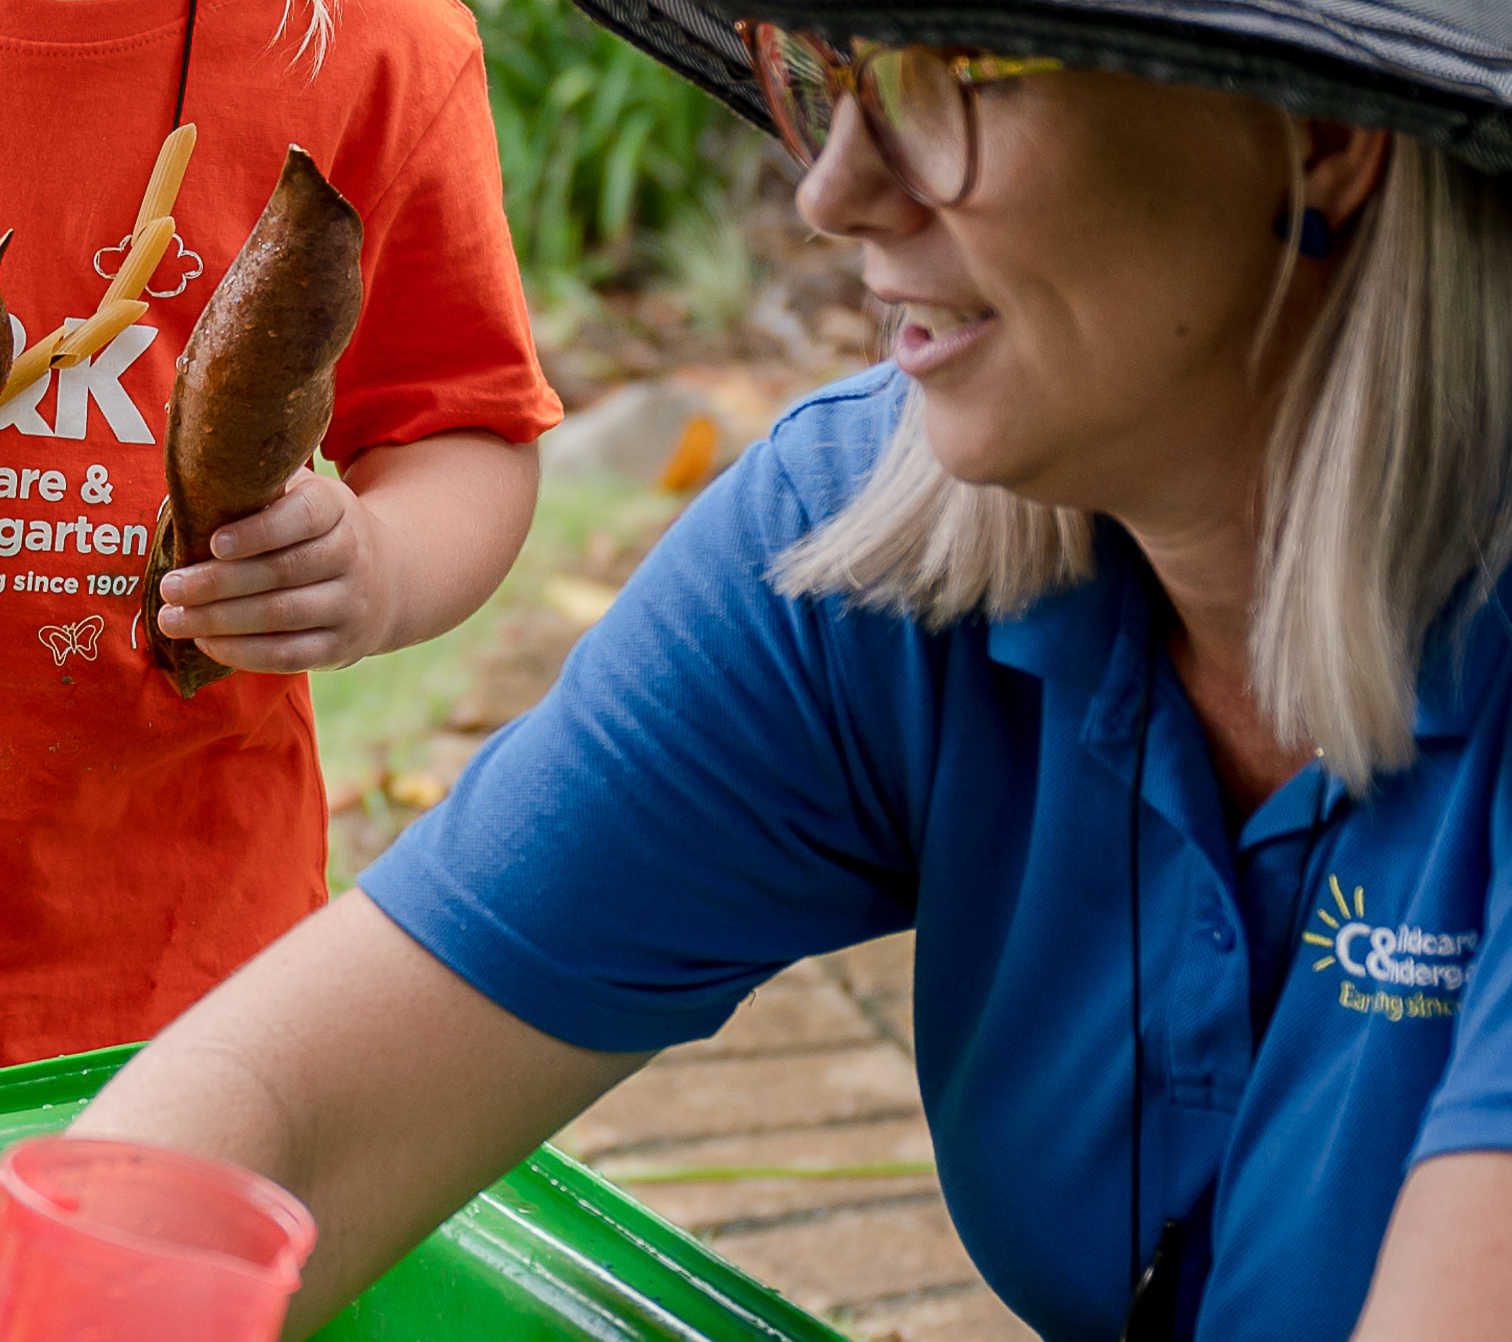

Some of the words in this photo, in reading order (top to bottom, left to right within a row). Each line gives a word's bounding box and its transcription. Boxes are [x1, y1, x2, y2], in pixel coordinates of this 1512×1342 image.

[80, 464, 114, 505] &
[13, 571, 79, 594] since
[86, 574, 140, 596] 1907
